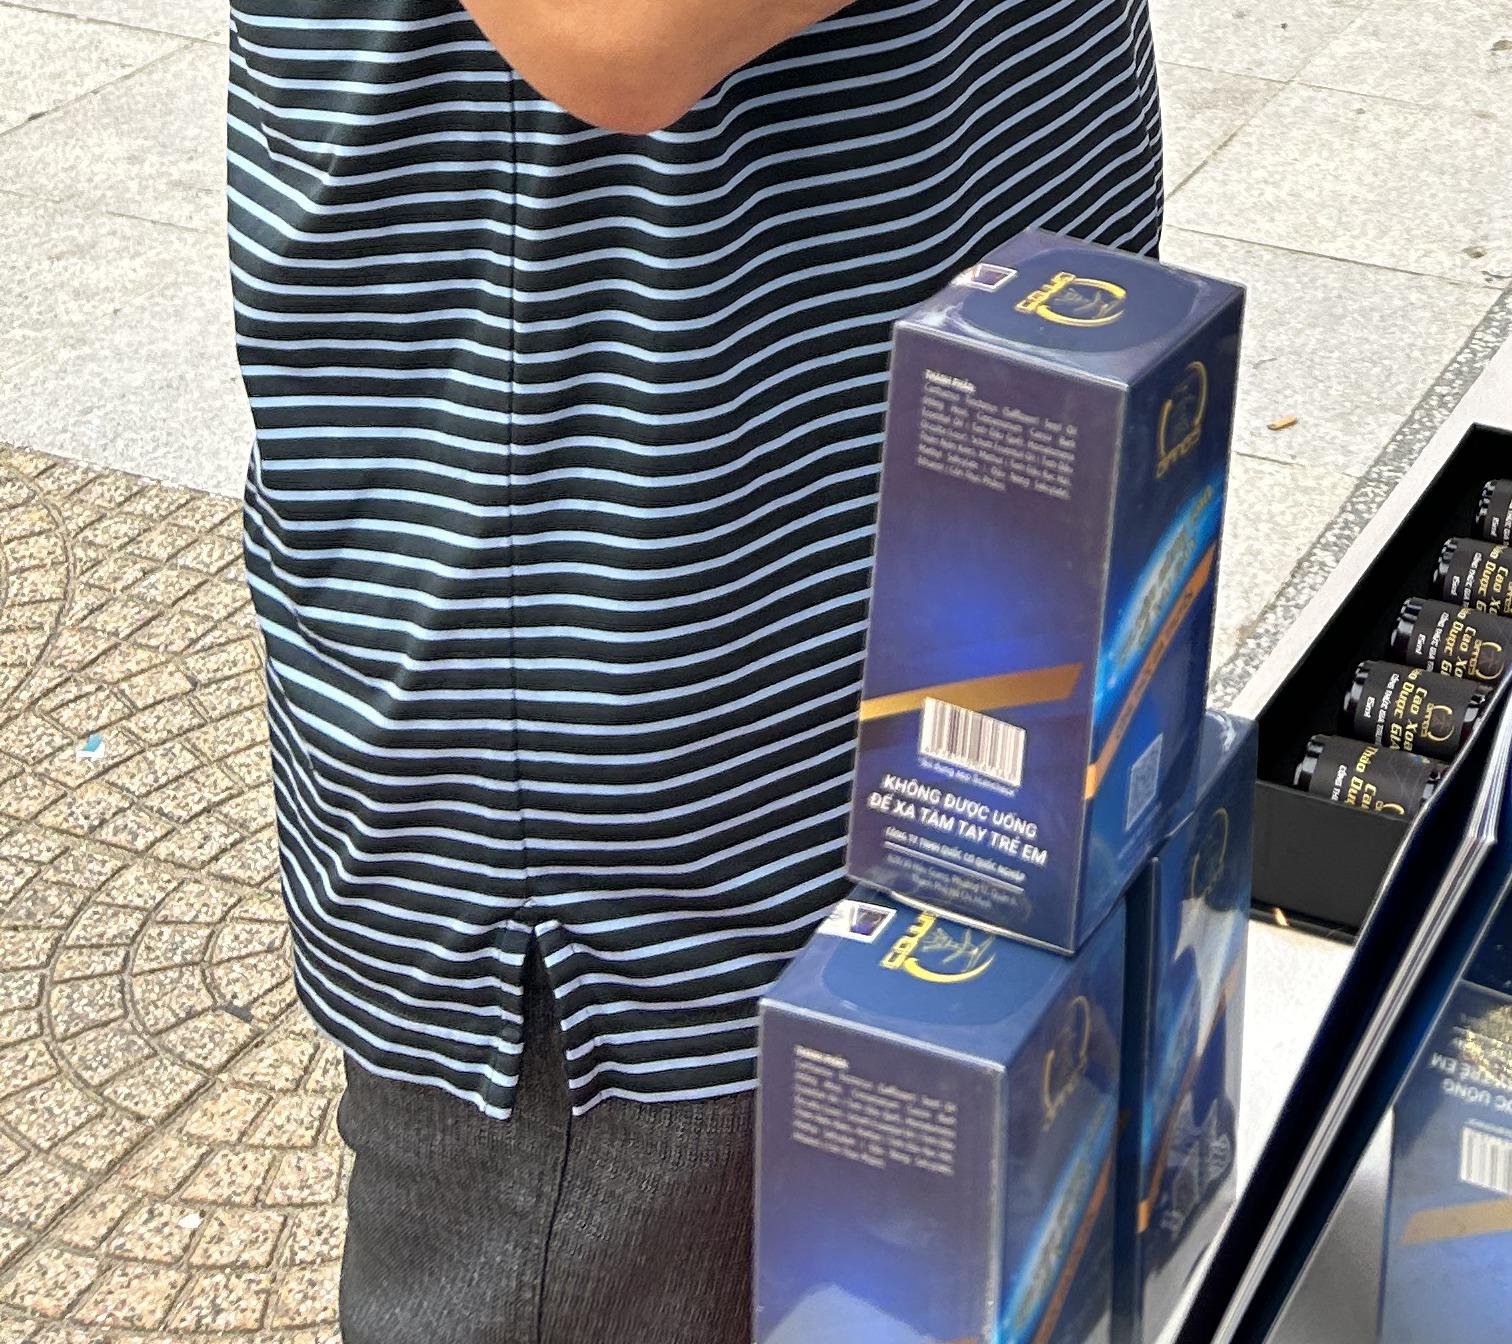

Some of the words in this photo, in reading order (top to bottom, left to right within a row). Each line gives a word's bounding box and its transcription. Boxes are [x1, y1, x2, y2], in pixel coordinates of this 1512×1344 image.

[1493, 566, 1509, 592] Cao
[1459, 626, 1477, 652] Cao
[1410, 687, 1428, 715] Cao
[882, 774, 943, 806] KHÔNG
[944, 792, 990, 821] ĐƯỢC
[894, 799, 916, 819] XA
[958, 819, 988, 843] TAY
[990, 830, 1021, 855] TRẺ
[1022, 845, 1049, 866] EM
